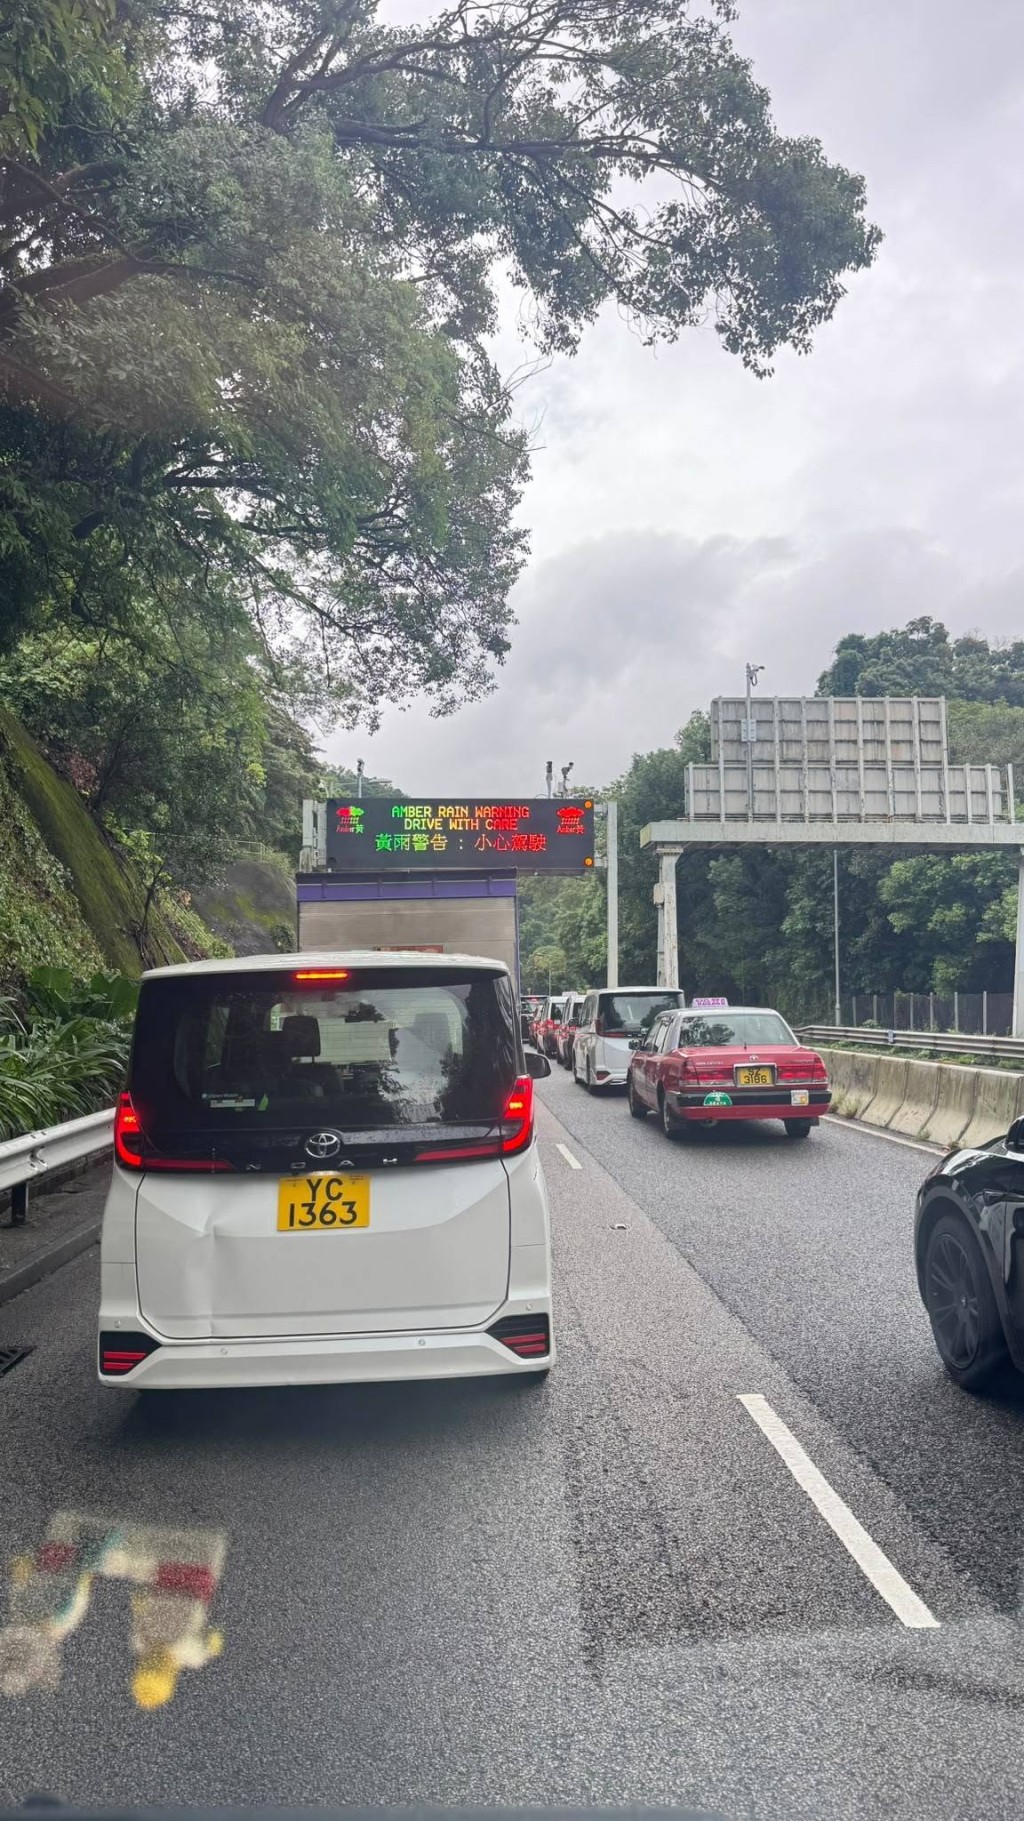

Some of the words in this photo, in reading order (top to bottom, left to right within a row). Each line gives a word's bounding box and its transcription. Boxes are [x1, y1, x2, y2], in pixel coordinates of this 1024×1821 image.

[391, 806, 432, 818] AMBER
[438, 806, 469, 818] RAIN
[475, 806, 530, 818] WARNING
[404, 818, 443, 830] DRIVE
[449, 818, 479, 830] WITH
[485, 818, 519, 830] CARE
[246, 1158, 398, 1170] NOAH
[306, 1178, 344, 1201] YC
[288, 1201, 358, 1228] 1363
